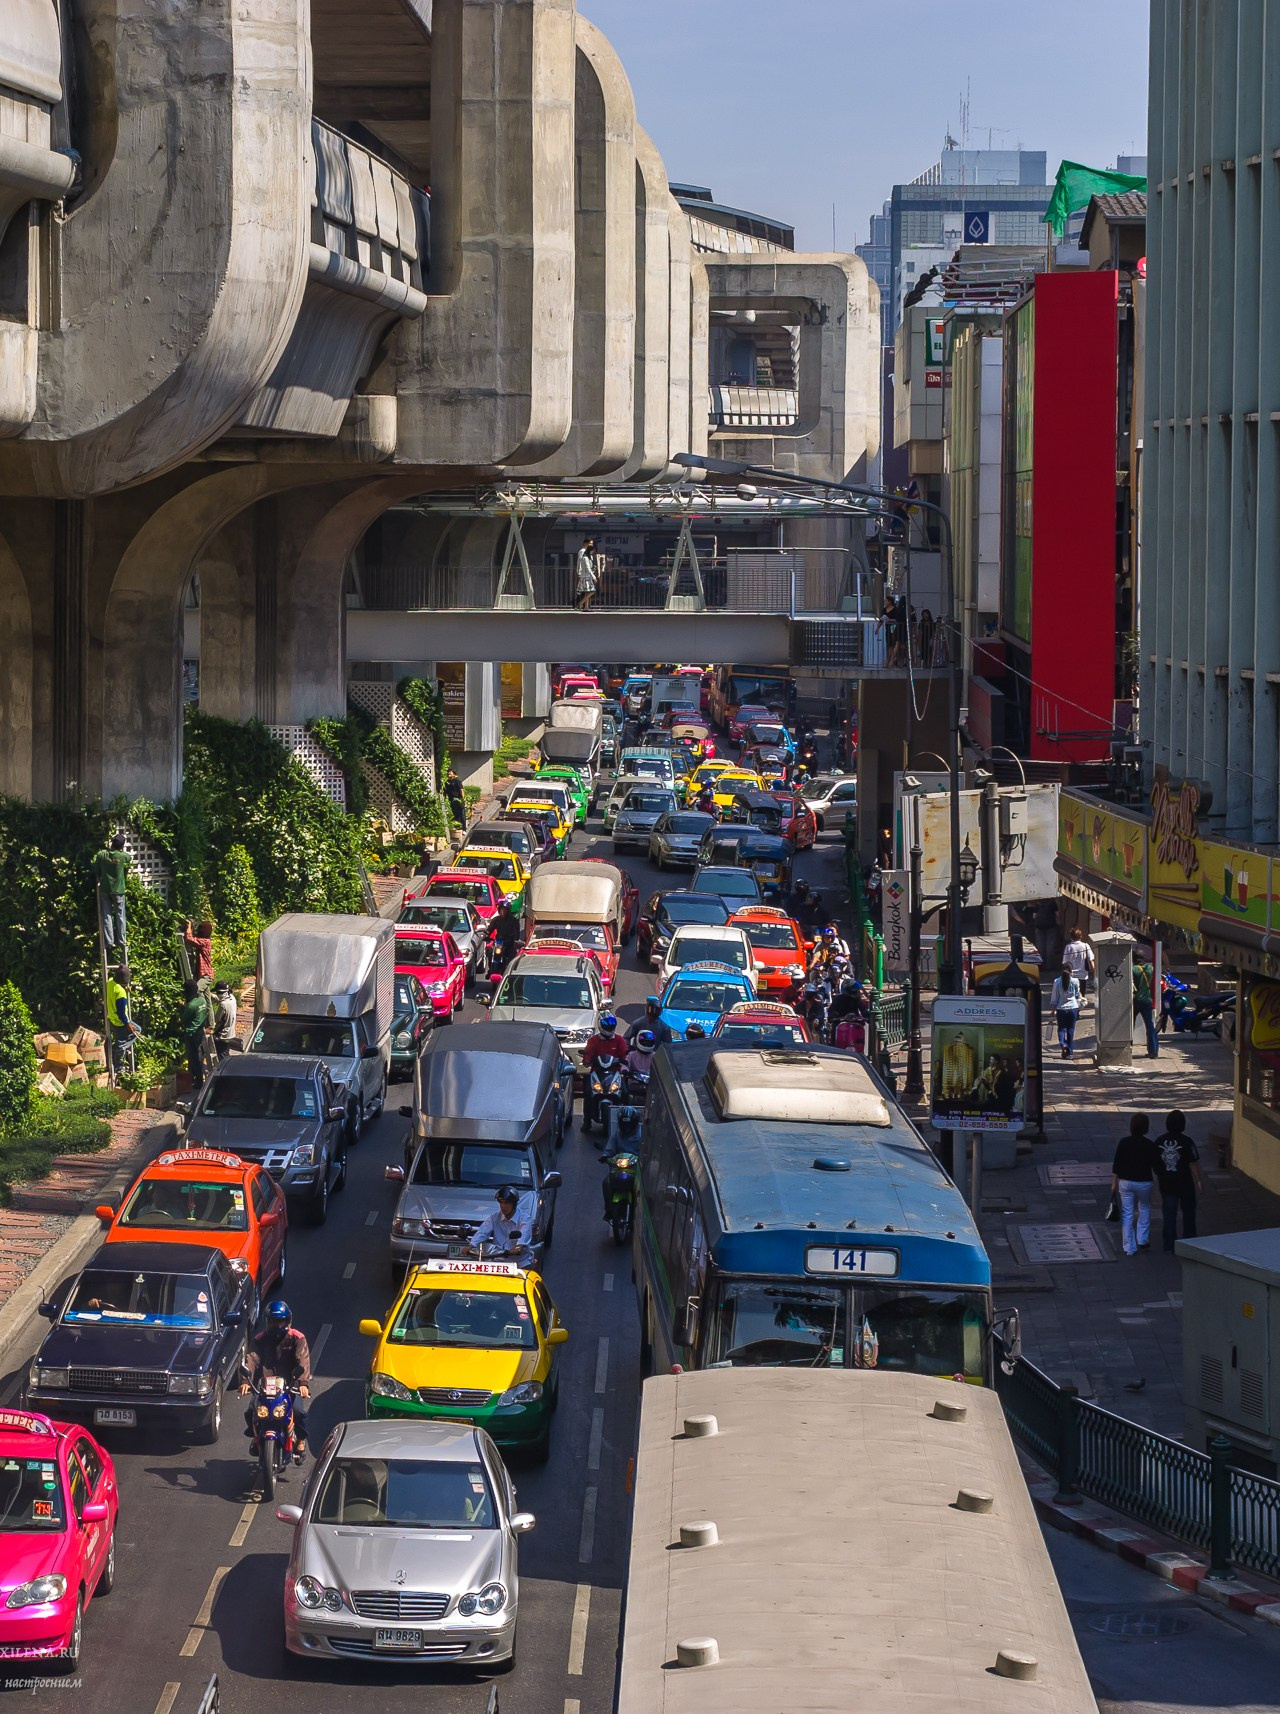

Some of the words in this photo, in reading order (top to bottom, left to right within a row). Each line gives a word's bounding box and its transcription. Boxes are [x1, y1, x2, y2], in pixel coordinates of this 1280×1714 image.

[887, 901, 906, 961] Bangkok
[832, 1248, 867, 1271] 141
[448, 1262, 510, 1274] TAXI-METER
[112, 1410, 133, 1420] 8153
[395, 1630, 420, 1642] 9829
